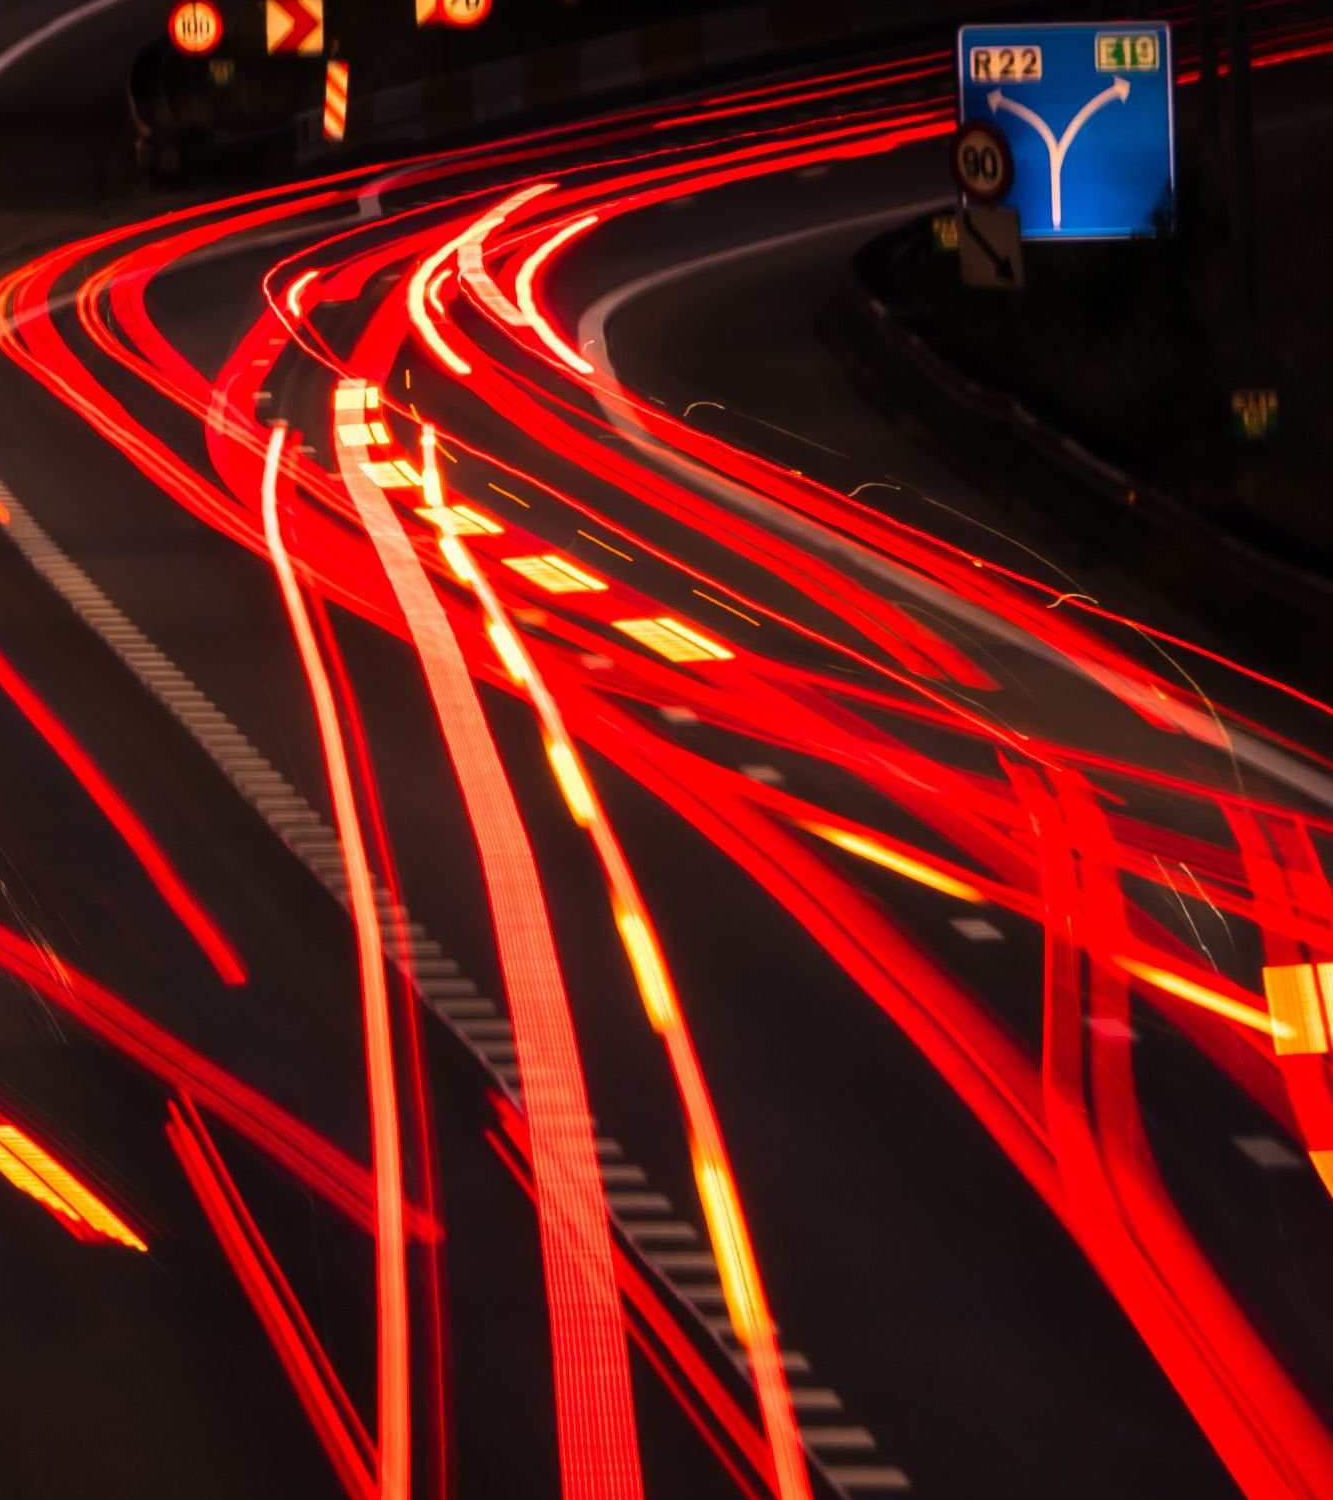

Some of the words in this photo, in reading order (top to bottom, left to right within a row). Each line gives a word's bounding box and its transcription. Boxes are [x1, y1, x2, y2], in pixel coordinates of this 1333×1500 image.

[180, 13, 210, 41] 100
[973, 49, 1039, 77] R22
[1100, 36, 1154, 67] E19
[962, 145, 998, 180] 90
